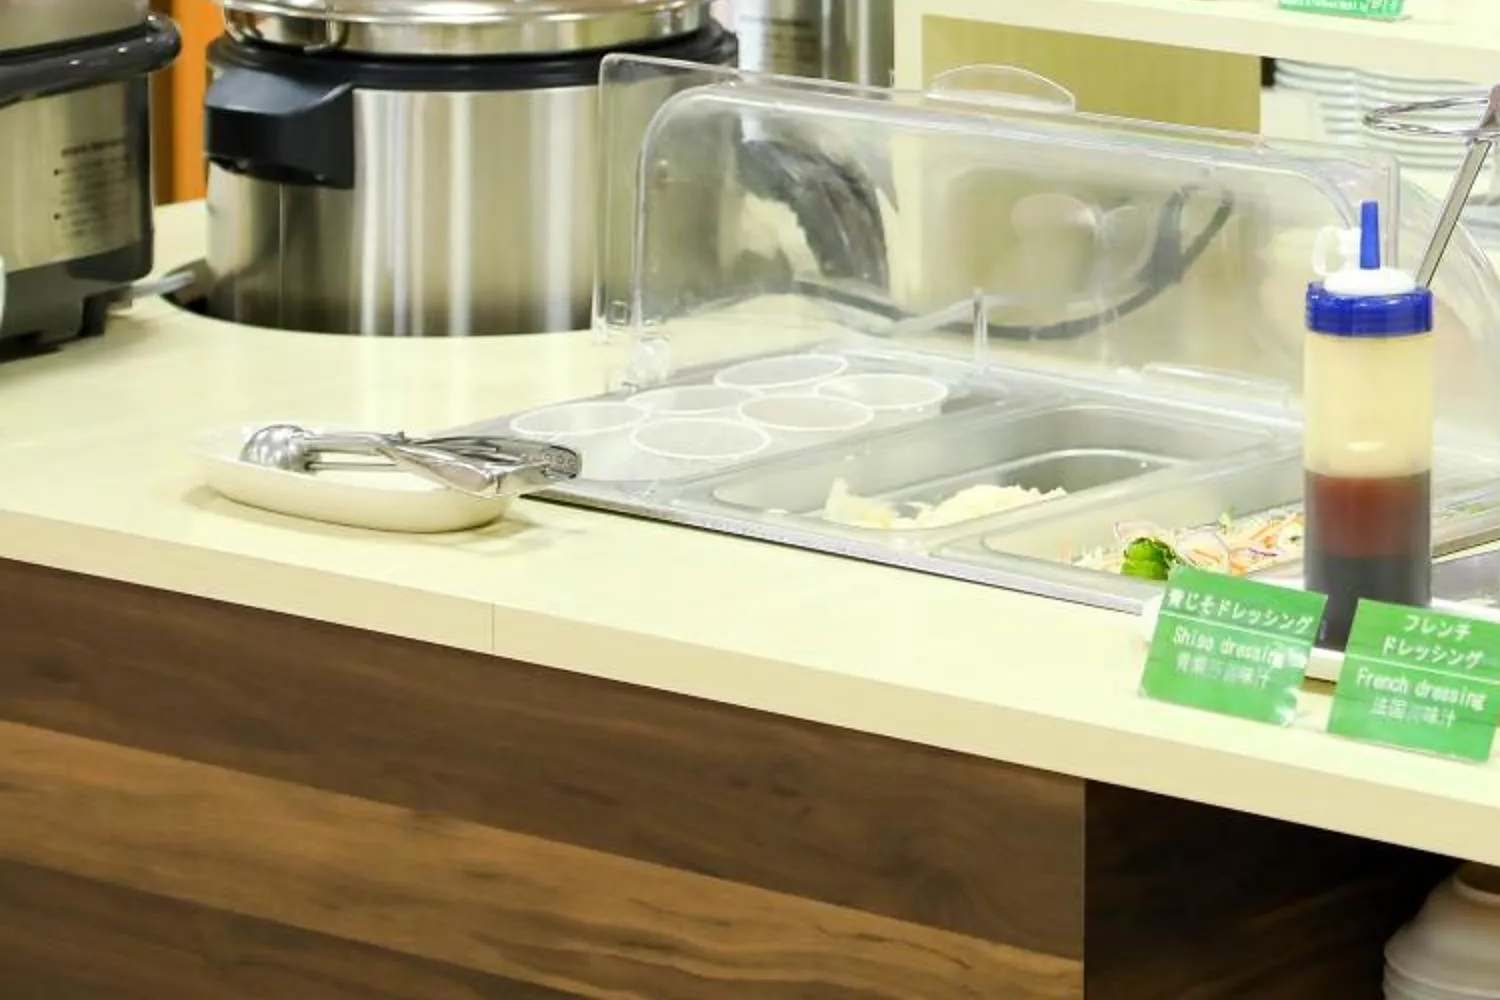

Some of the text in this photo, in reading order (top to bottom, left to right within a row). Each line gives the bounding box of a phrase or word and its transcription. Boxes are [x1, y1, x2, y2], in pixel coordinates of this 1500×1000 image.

[1167, 587, 1315, 634] 青じそドレッシング
[1404, 614, 1472, 642] フレンチ
[1173, 624, 1284, 669] Shiso dressing
[1383, 635, 1484, 669] ドレッシング
[1356, 666, 1487, 712] French dressing
